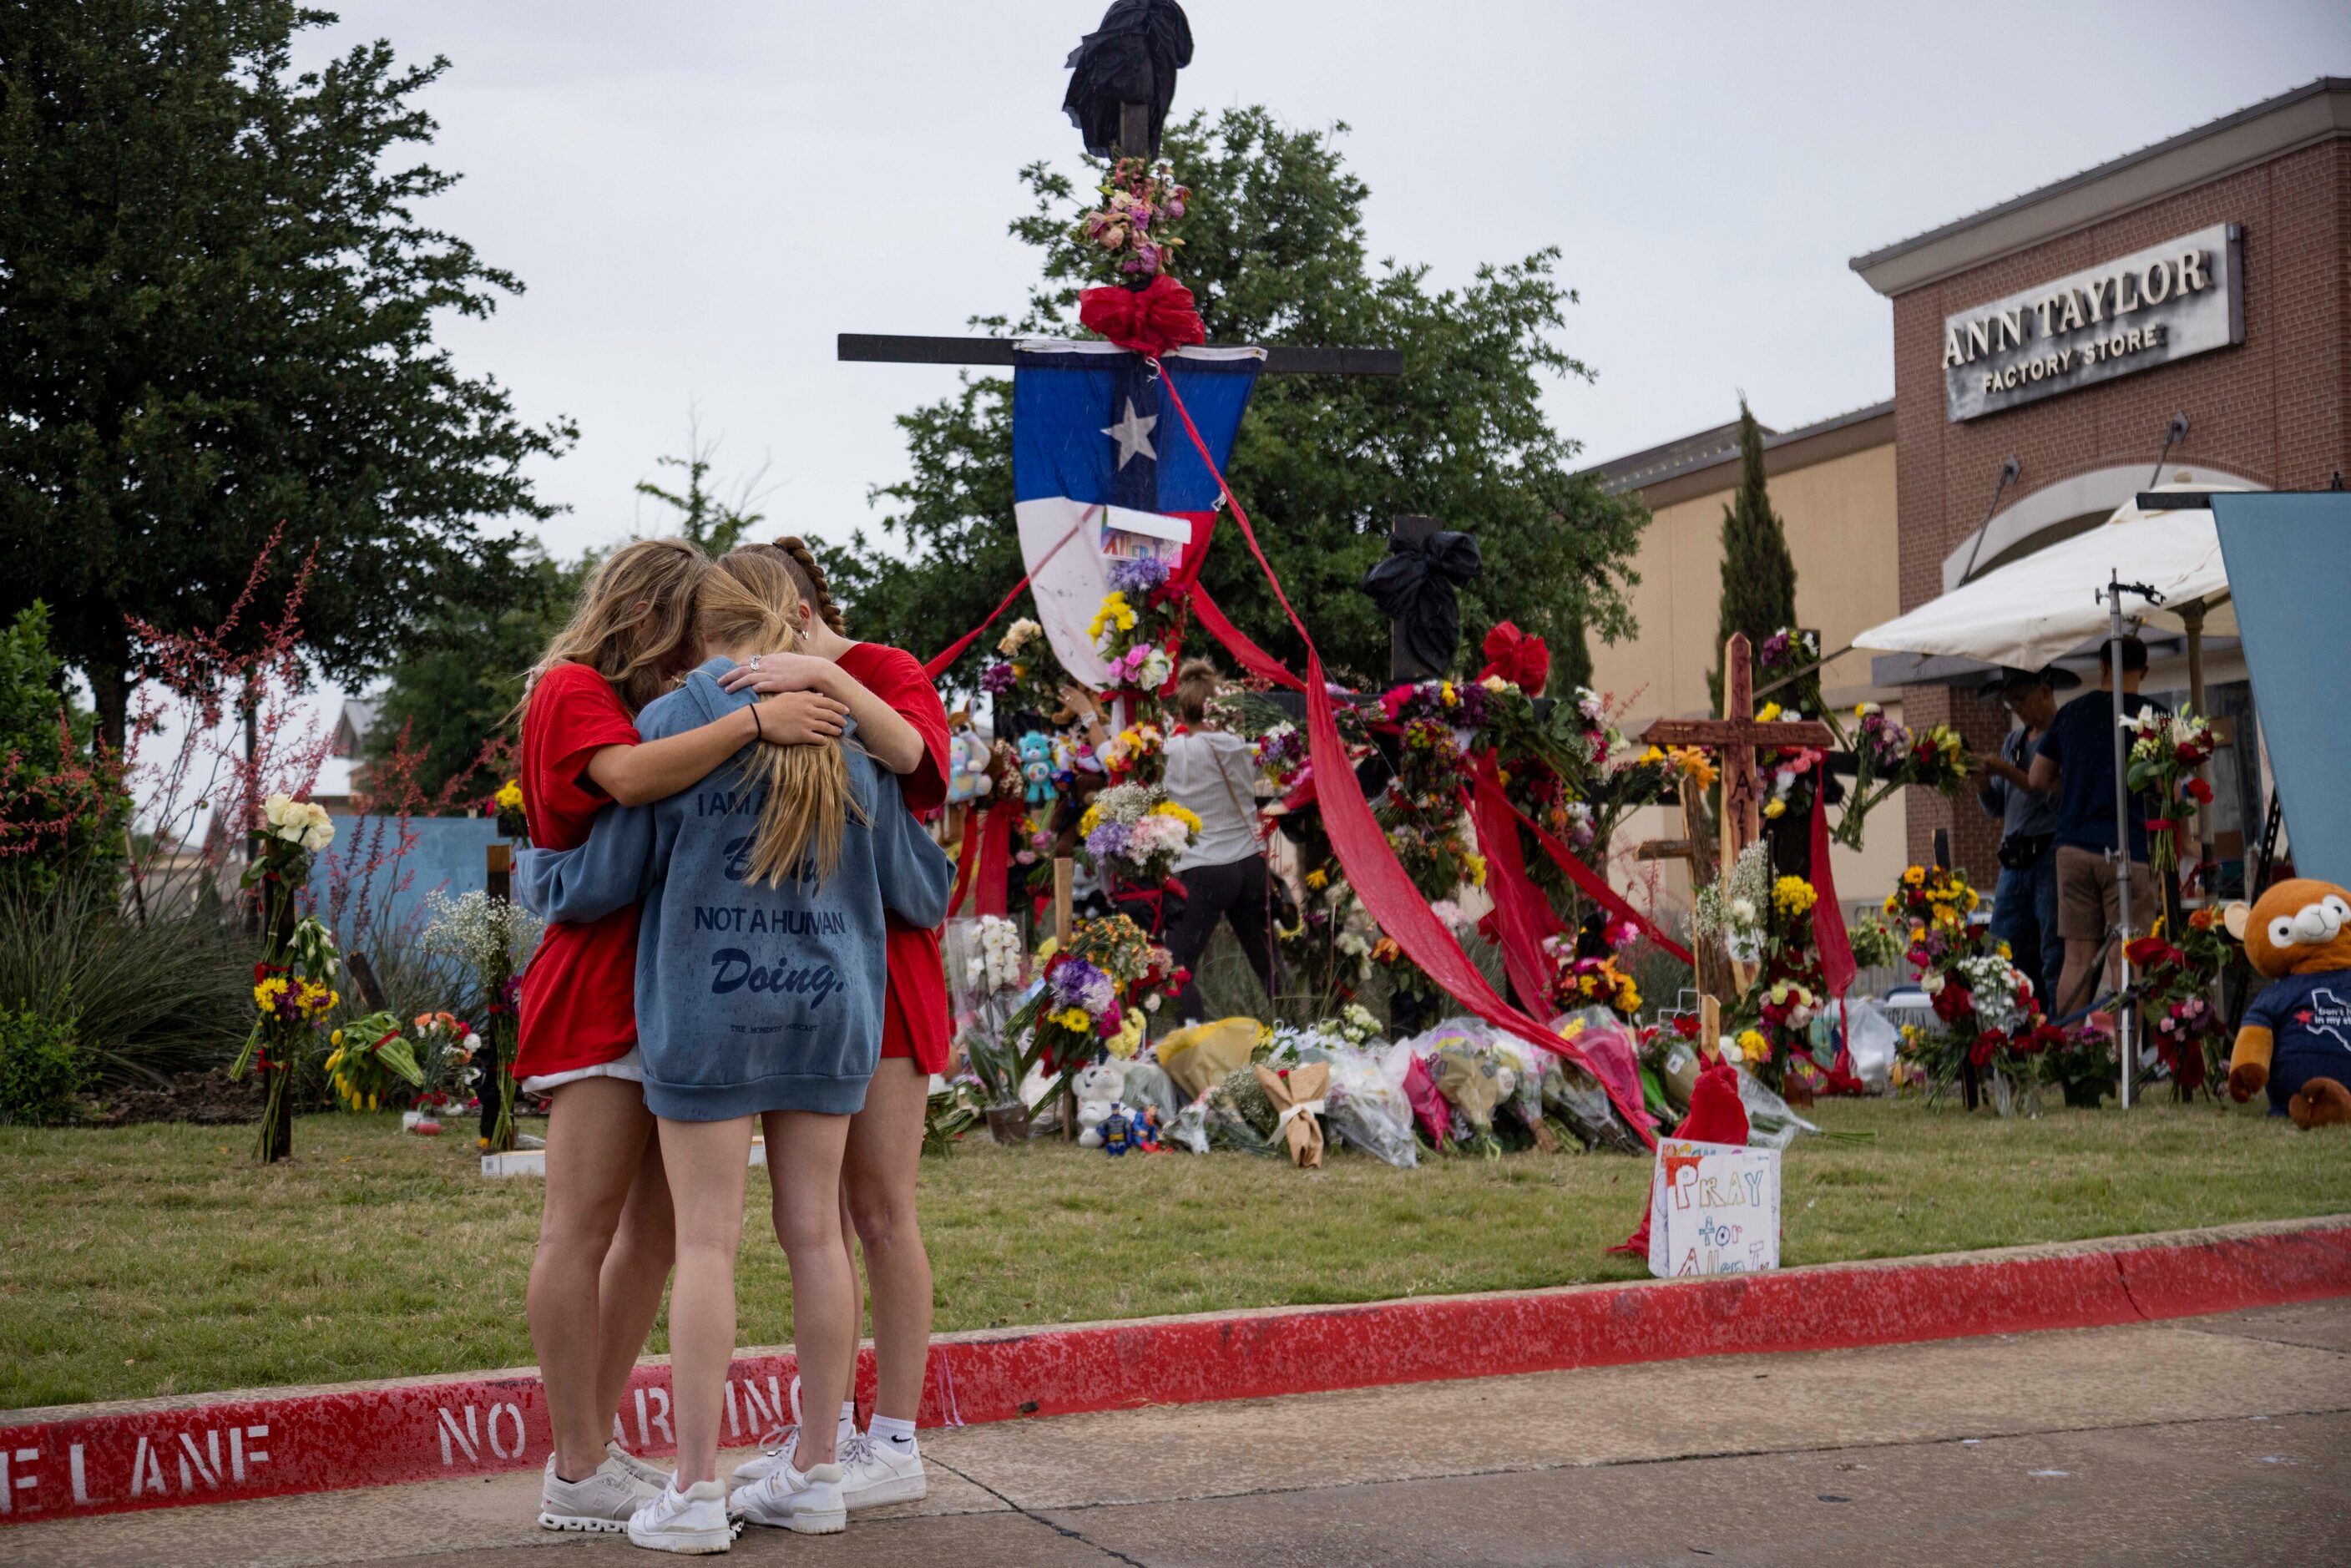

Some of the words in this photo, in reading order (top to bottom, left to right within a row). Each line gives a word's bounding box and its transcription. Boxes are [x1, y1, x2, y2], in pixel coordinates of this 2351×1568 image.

[1942, 307, 2022, 370] ANN
[2035, 248, 2207, 339] TAYLOR
[1982, 348, 2072, 395] FACTORY
[2082, 322, 2158, 366] STORE
[697, 793, 705, 817] I
[708, 792, 750, 817] AM
[695, 906, 746, 933] NOT
[749, 908, 769, 933] A
[771, 909, 847, 935] HUMAN
[711, 948, 845, 1010] Doing.
[437, 1402, 526, 1465] NO
